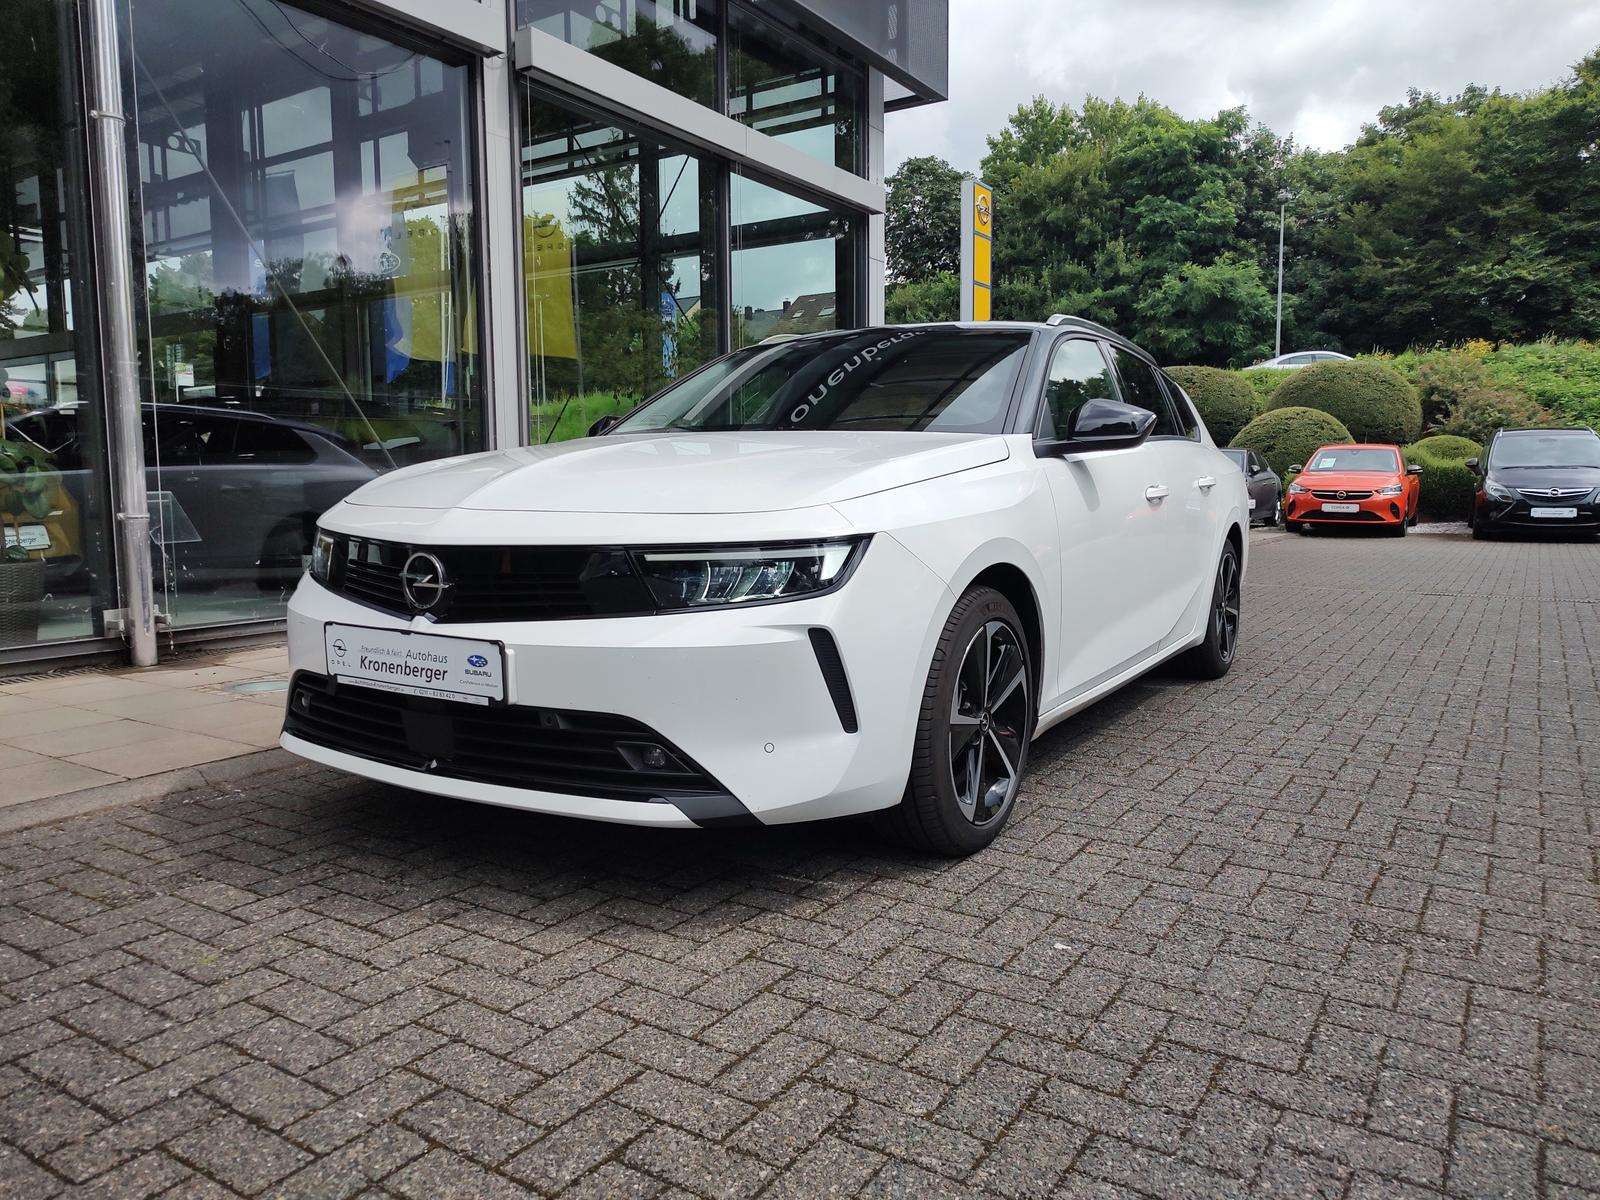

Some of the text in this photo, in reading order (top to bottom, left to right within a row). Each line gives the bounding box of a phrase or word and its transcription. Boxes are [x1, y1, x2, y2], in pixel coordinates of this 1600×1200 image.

[405, 649, 448, 664] Autohaus
[360, 655, 448, 683] Kronenberger
[464, 669, 492, 678] SUBARU
